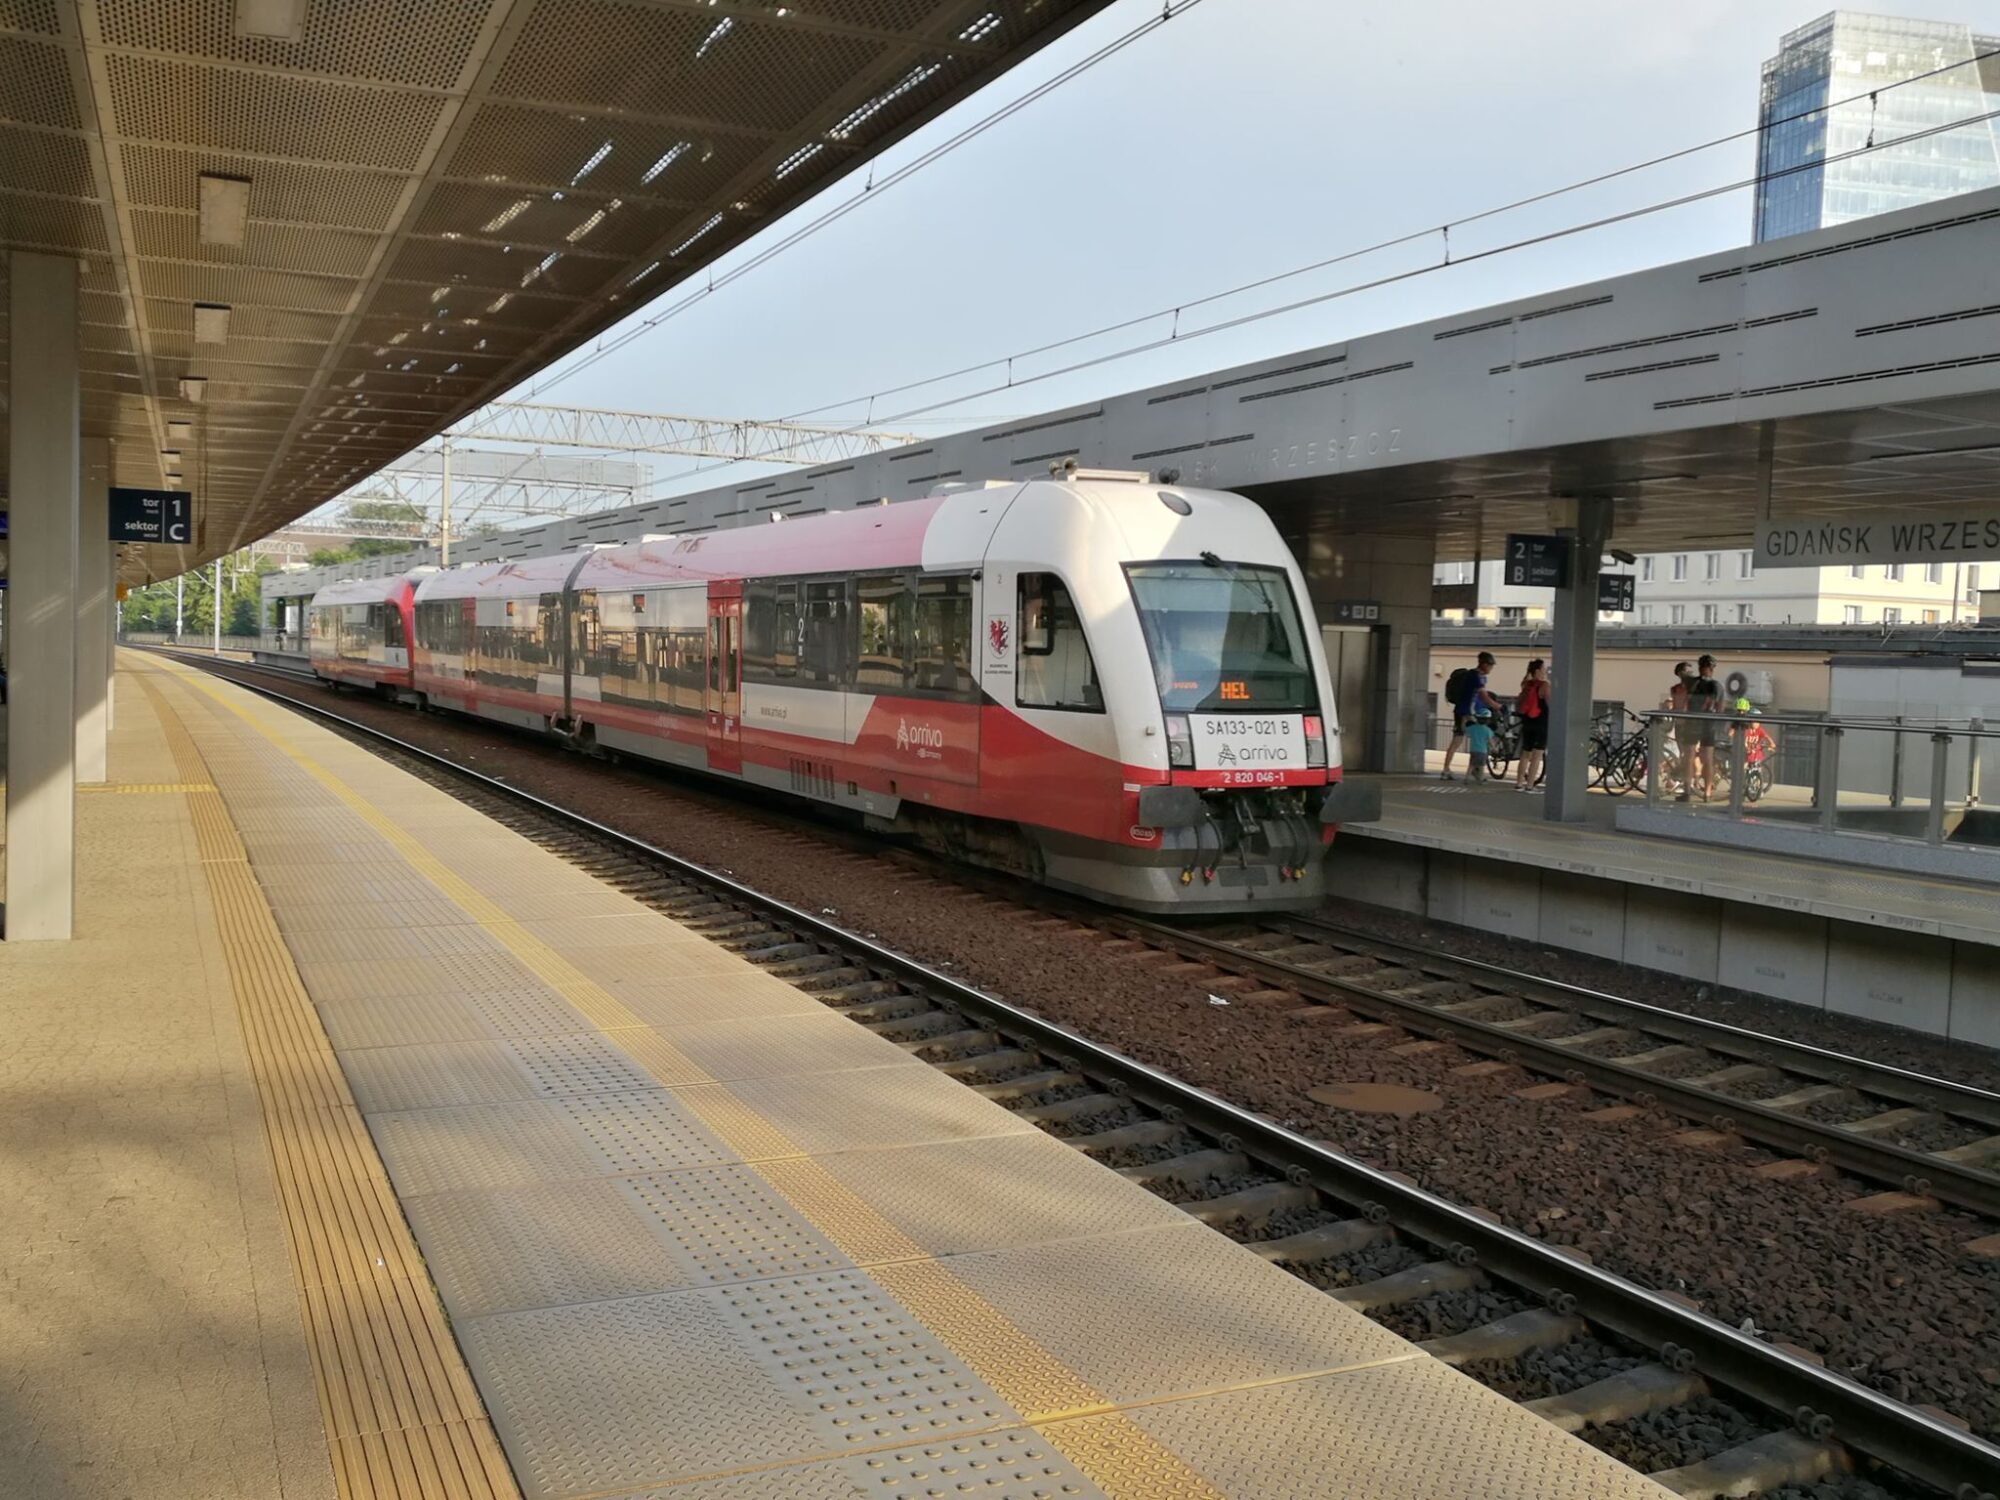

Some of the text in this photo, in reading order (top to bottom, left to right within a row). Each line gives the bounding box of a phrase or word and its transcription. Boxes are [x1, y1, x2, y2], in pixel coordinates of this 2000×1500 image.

[142, 498, 181, 517] tor 1
[124, 520, 184, 541] sektor C
[1766, 518, 2000, 556] GDAŃSK WRZES
[1515, 542, 1526, 559] 2
[1513, 566, 1525, 582] B
[1623, 580, 1633, 594] 4
[1622, 597, 1631, 610] B
[798, 618, 804, 642] 2
[1221, 681, 1249, 699] HEL
[910, 722, 942, 748] arriva
[1206, 720, 1290, 735] SA133-021 B
[1239, 744, 1288, 761] arriva
[1223, 771, 1285, 783] 2 820 046-1
